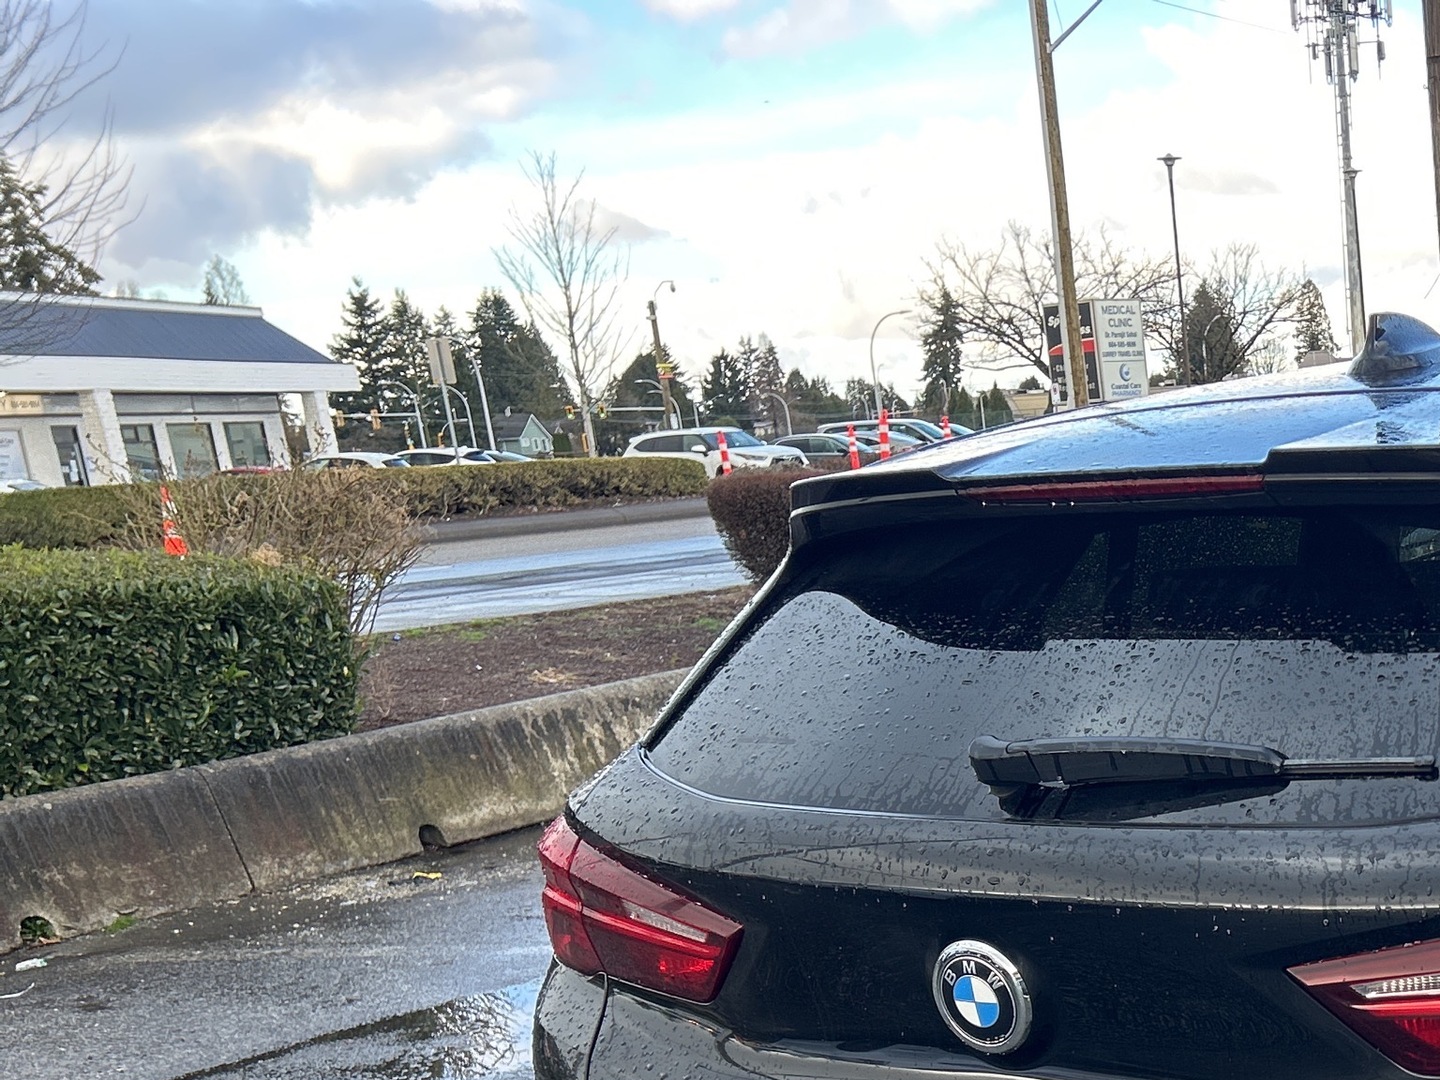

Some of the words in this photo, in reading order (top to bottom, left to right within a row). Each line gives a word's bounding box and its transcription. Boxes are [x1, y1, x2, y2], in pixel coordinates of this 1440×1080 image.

[1101, 305, 1136, 315] MEDICAL
[1108, 318, 1133, 328] CLINIC
[944, 960, 1005, 990] BMW
